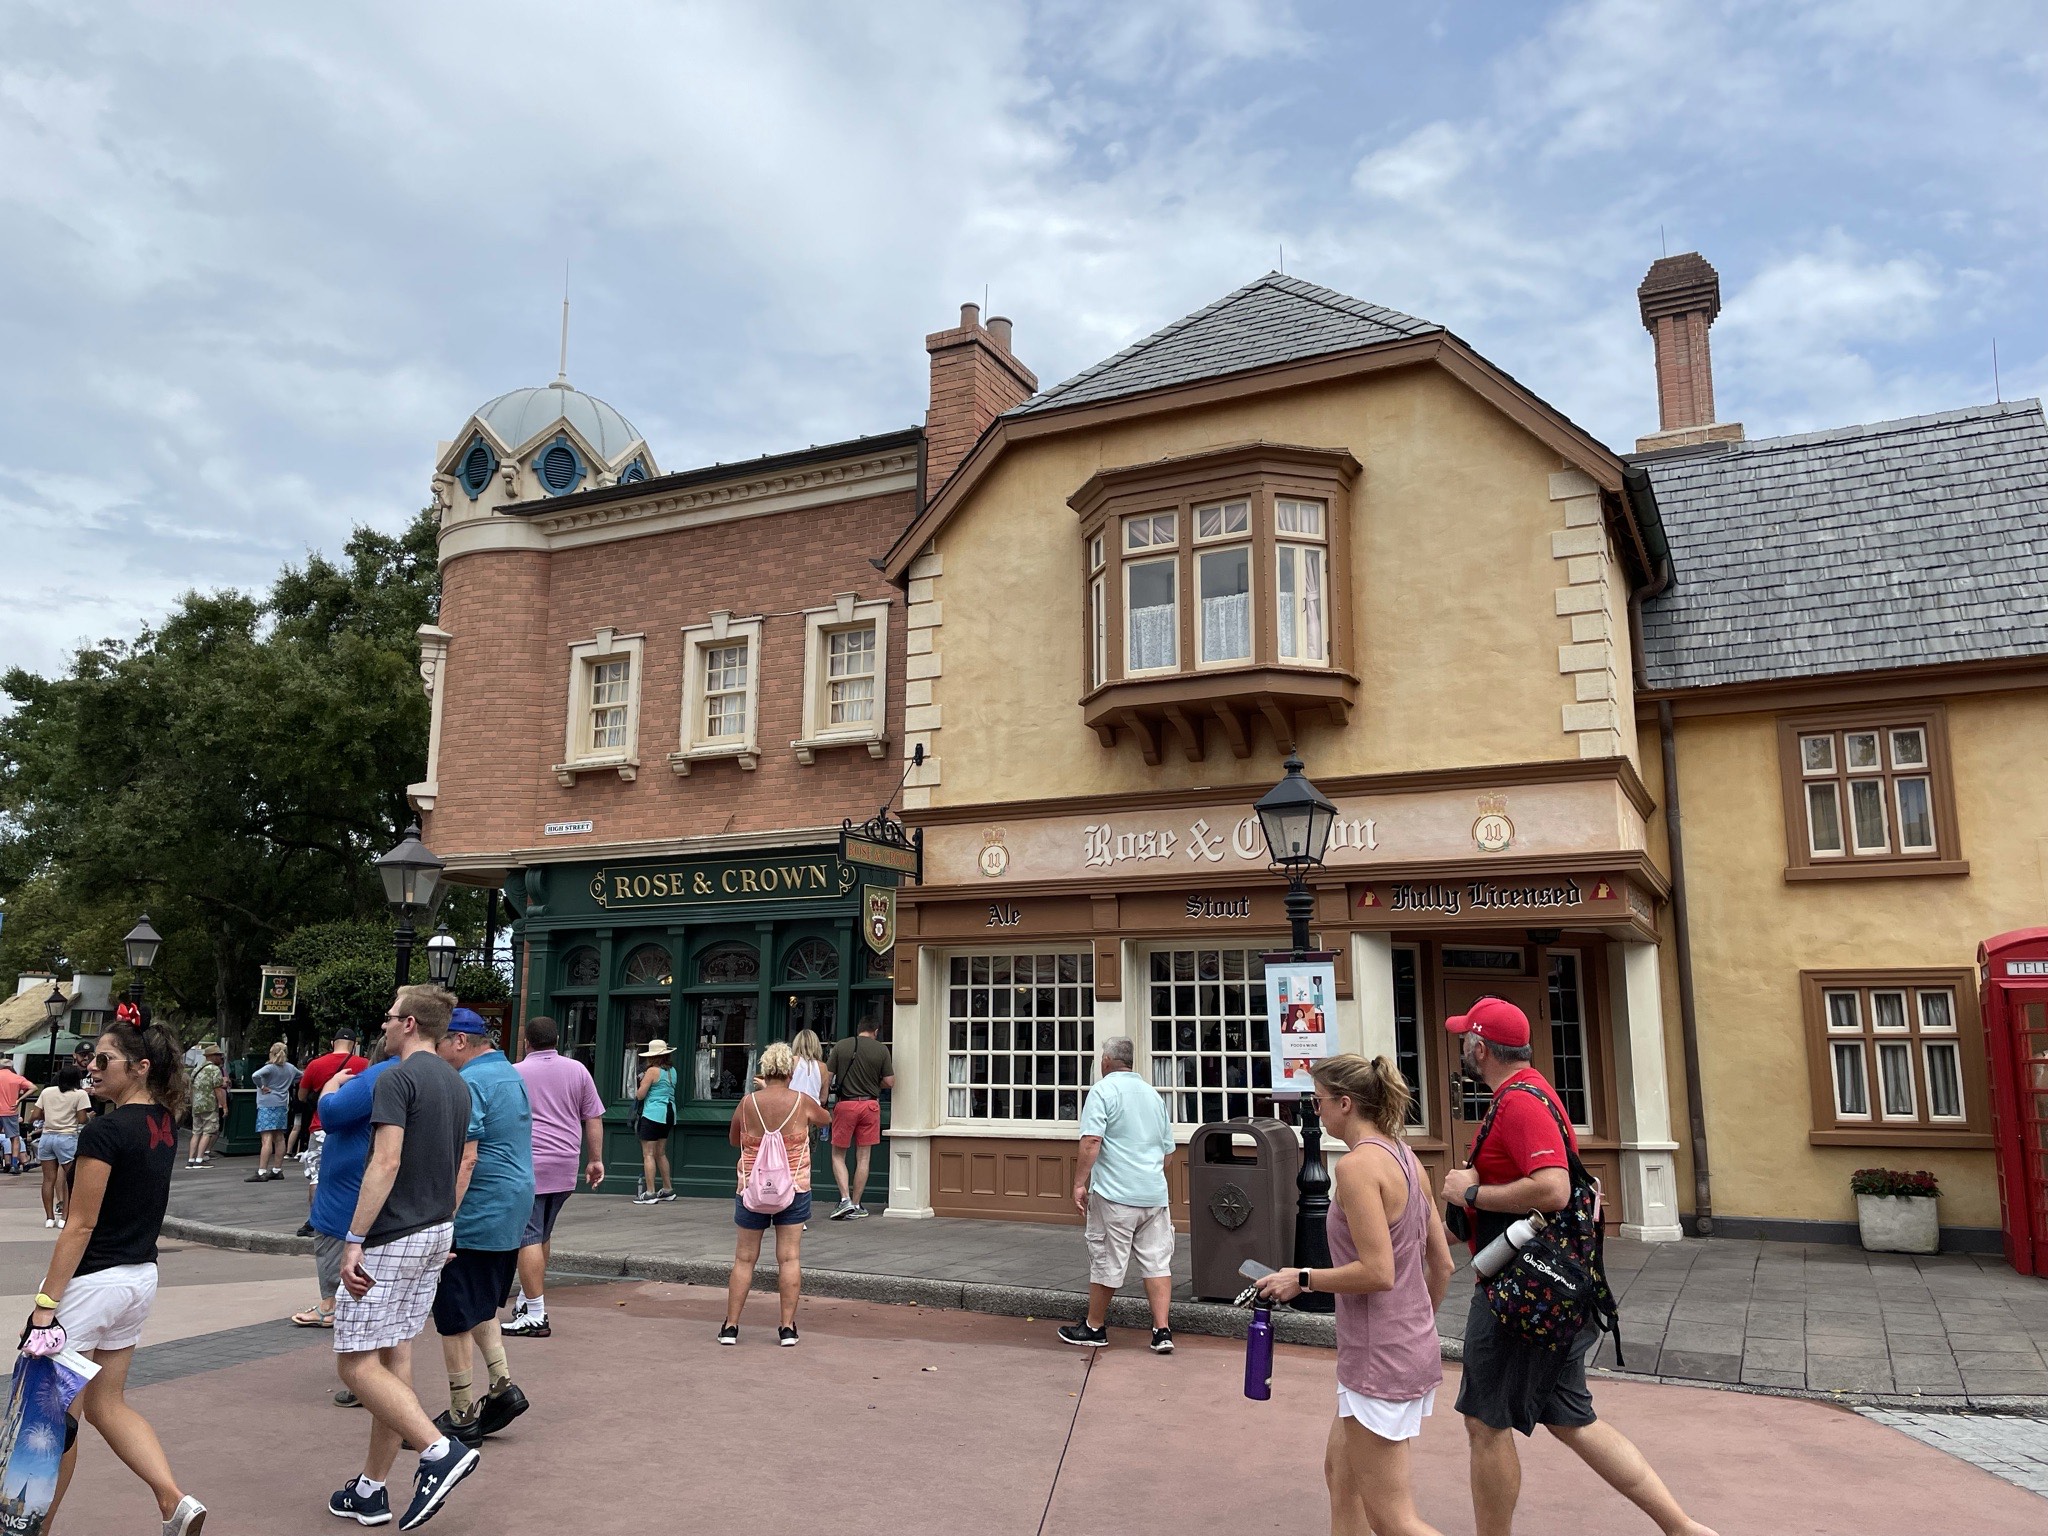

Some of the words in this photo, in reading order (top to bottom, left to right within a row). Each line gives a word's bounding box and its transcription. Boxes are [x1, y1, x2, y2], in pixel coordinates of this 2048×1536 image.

[1084, 823, 1179, 868] Rose
[1185, 818, 1225, 862] &
[1232, 814, 1379, 860] Cwn
[848, 842, 872, 861] ROSE
[874, 848, 881, 862] &
[882, 848, 915, 869] CROWN
[614, 872, 685, 899] ROSE
[692, 871, 715, 895] &
[721, 864, 828, 893] CROWN
[842, 867, 849, 882] 9
[594, 883, 601, 895] 9
[1391, 884, 1461, 916] Fully
[1467, 878, 1583, 909] Licensed
[986, 903, 1022, 928] Ale
[1185, 894, 1251, 919] Stout
